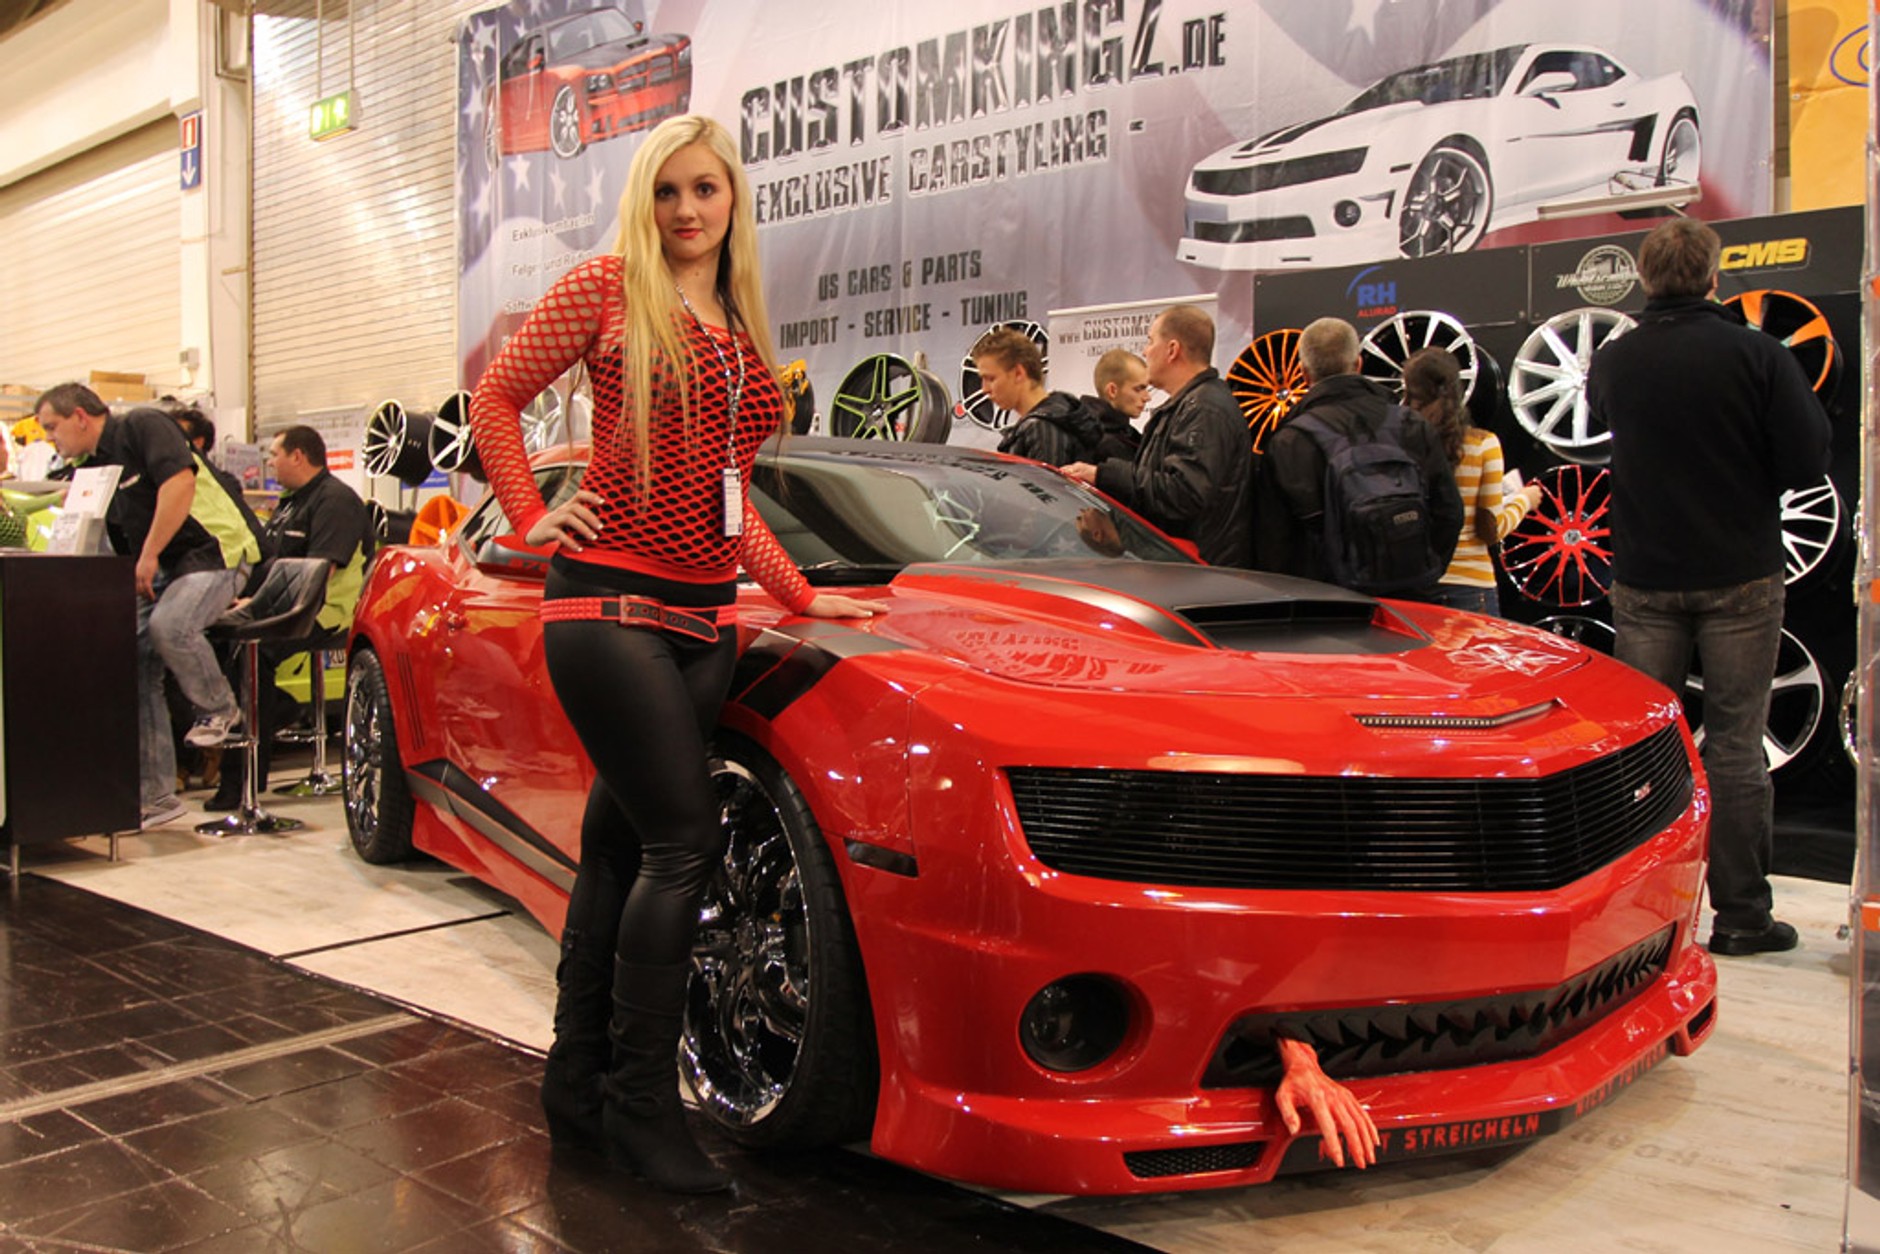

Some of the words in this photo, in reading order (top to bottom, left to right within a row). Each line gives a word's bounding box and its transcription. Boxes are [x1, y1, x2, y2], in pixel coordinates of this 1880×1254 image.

[756, 155, 891, 225] EXCLUSIVE
[908, 109, 1107, 193] CARSTYLING
[818, 273, 838, 301] US
[847, 264, 891, 297] CARS
[903, 261, 911, 288] &
[922, 250, 982, 285] PARTS
[1719, 238, 1808, 270] CMS
[1357, 281, 1397, 307] RH
[780, 316, 838, 349] IMPORT
[864, 303, 931, 337] SERVICE
[961, 290, 1027, 326] TUNING
[1404, 1115, 1540, 1151] STREICHELN
